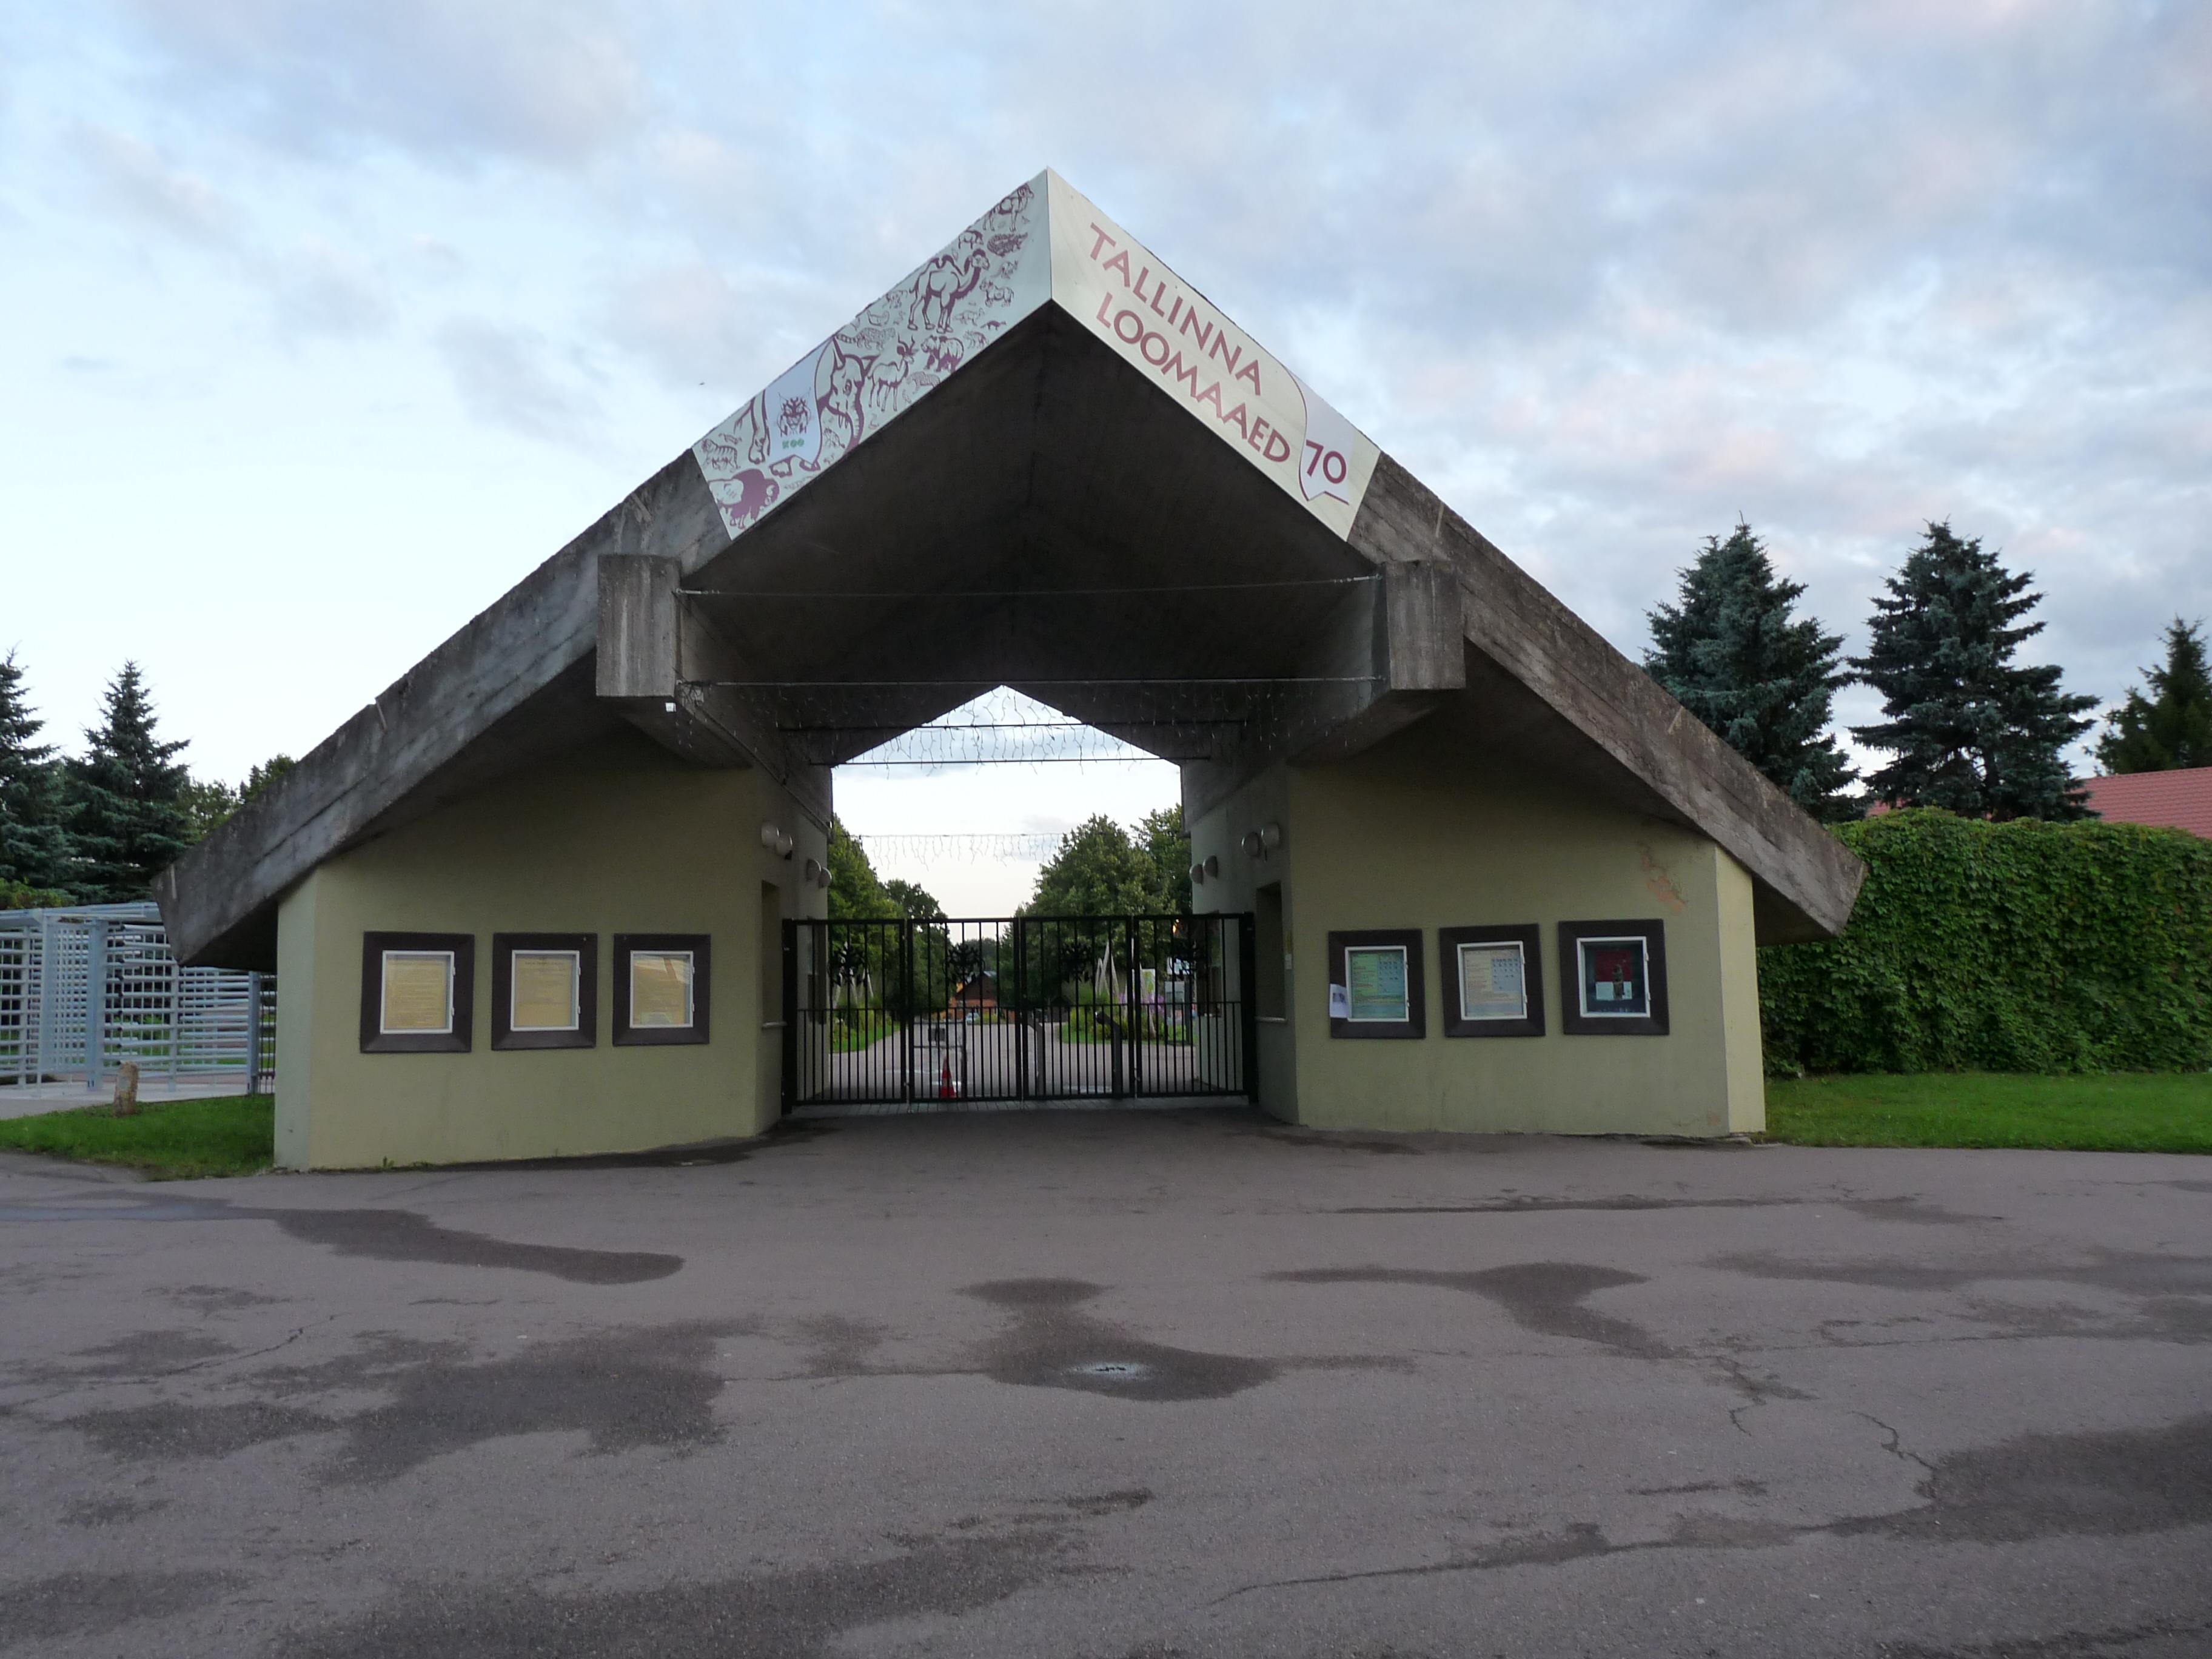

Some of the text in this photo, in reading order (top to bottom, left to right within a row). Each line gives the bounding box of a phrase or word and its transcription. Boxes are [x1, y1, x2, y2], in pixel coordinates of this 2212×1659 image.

[1090, 222, 1261, 396] TALLINNA
[1096, 292, 1290, 463] LOOMAAED
[1305, 439, 1347, 484] 70
